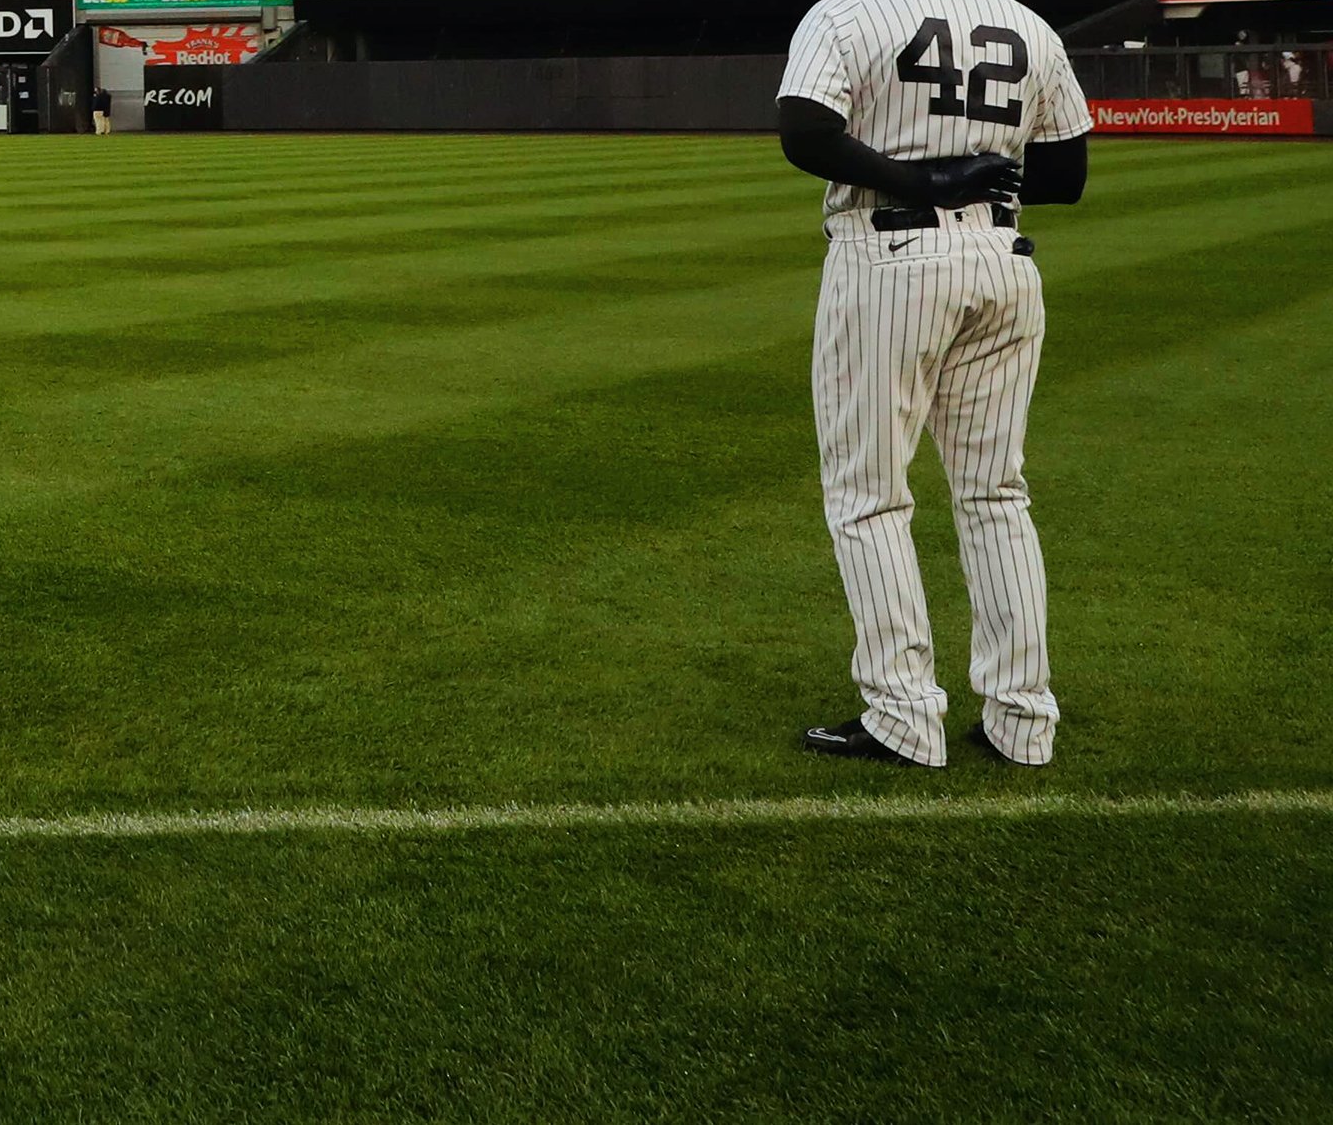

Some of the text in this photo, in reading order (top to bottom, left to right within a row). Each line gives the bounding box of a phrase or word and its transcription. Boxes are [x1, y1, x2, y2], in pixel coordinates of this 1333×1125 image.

[176, 50, 231, 65] RedHot
[896, 17, 1028, 128] 42
[144, 86, 213, 108] RE.COM
